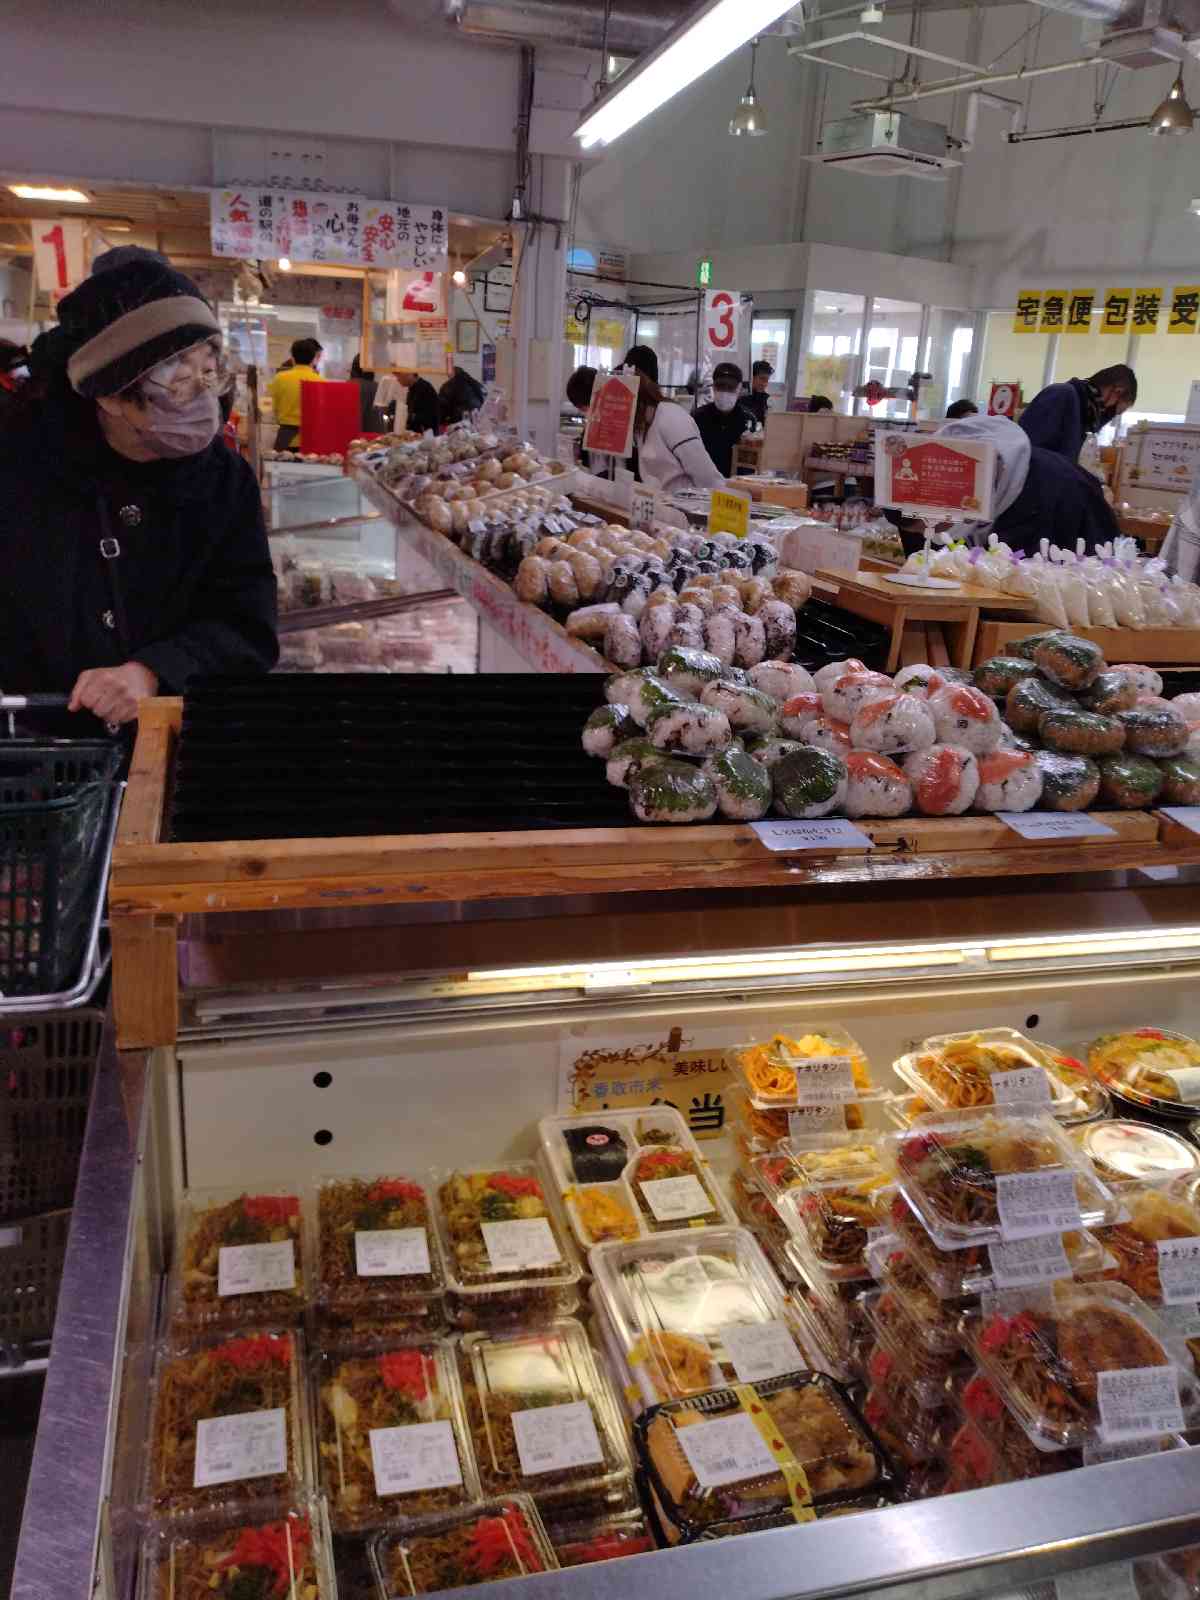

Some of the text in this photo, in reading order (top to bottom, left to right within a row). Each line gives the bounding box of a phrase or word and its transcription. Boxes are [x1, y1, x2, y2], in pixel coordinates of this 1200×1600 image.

[346, 202, 359, 256] お母さん
[379, 212, 395, 250] 安心
[397, 206, 410, 241] 地元の
[413, 222, 428, 268] やさしい
[41, 224, 68, 288] 1
[709, 292, 734, 347] 3
[1016, 296, 1094, 326] 宅急便
[1104, 294, 1160, 326] 包装
